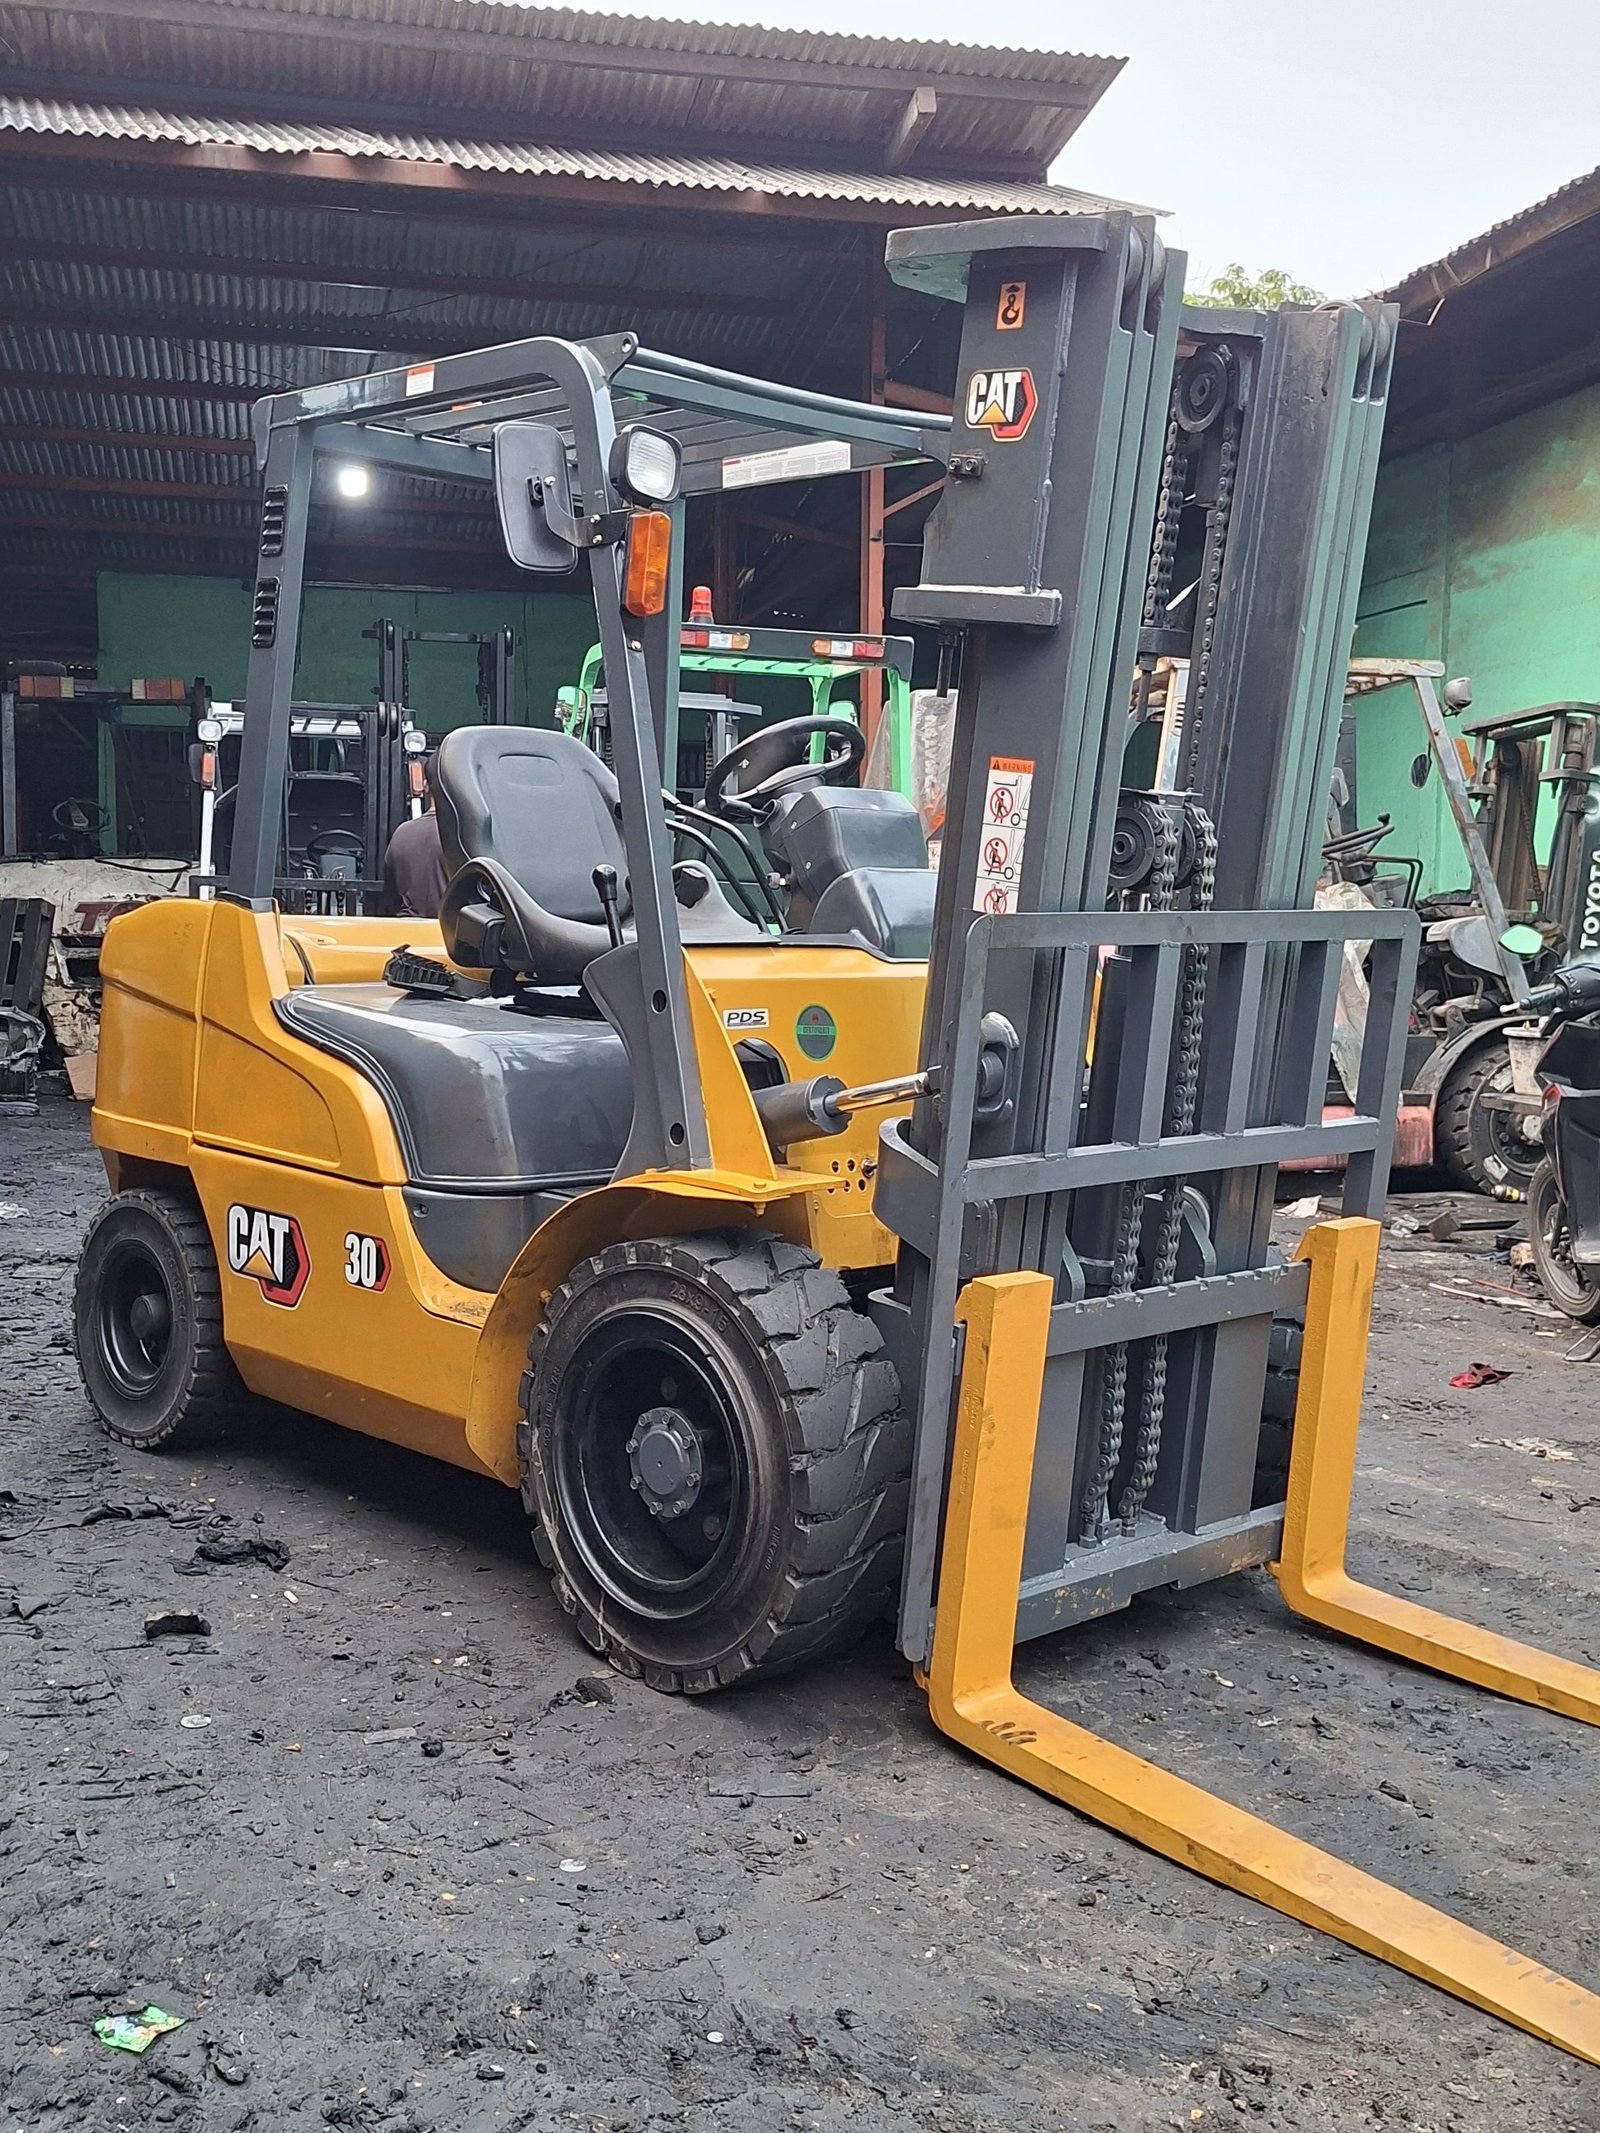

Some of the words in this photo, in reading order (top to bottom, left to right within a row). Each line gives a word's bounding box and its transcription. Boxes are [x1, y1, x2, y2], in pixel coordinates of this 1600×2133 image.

[968, 371, 1022, 424] CAT
[727, 1011, 766, 1023] PDS
[229, 1205, 289, 1283] CAT
[344, 1233, 377, 1288] 30
